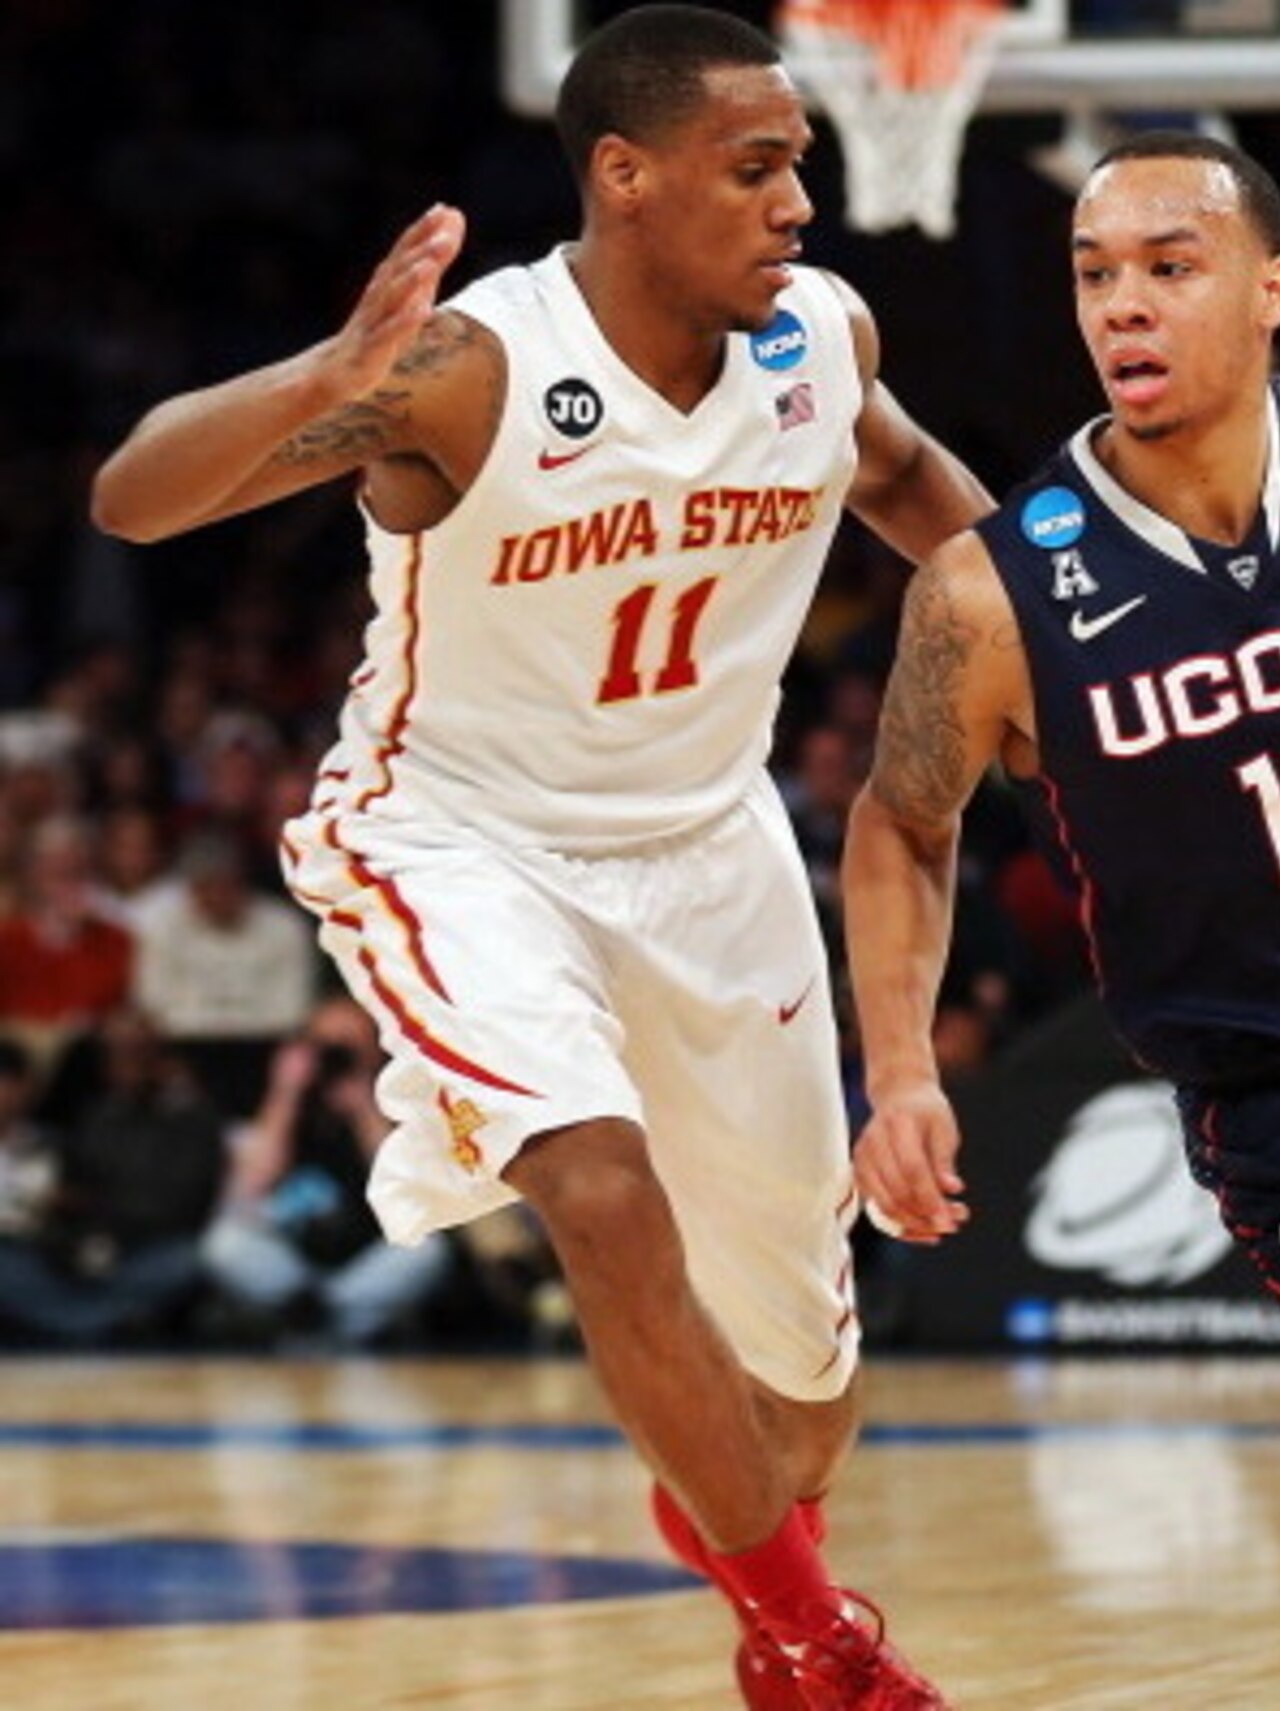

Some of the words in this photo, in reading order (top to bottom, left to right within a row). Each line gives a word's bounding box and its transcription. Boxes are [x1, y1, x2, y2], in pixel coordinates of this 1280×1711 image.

[490, 498, 658, 586] IOWA
[1051, 549, 1100, 600] A
[595, 574, 720, 706] 11
